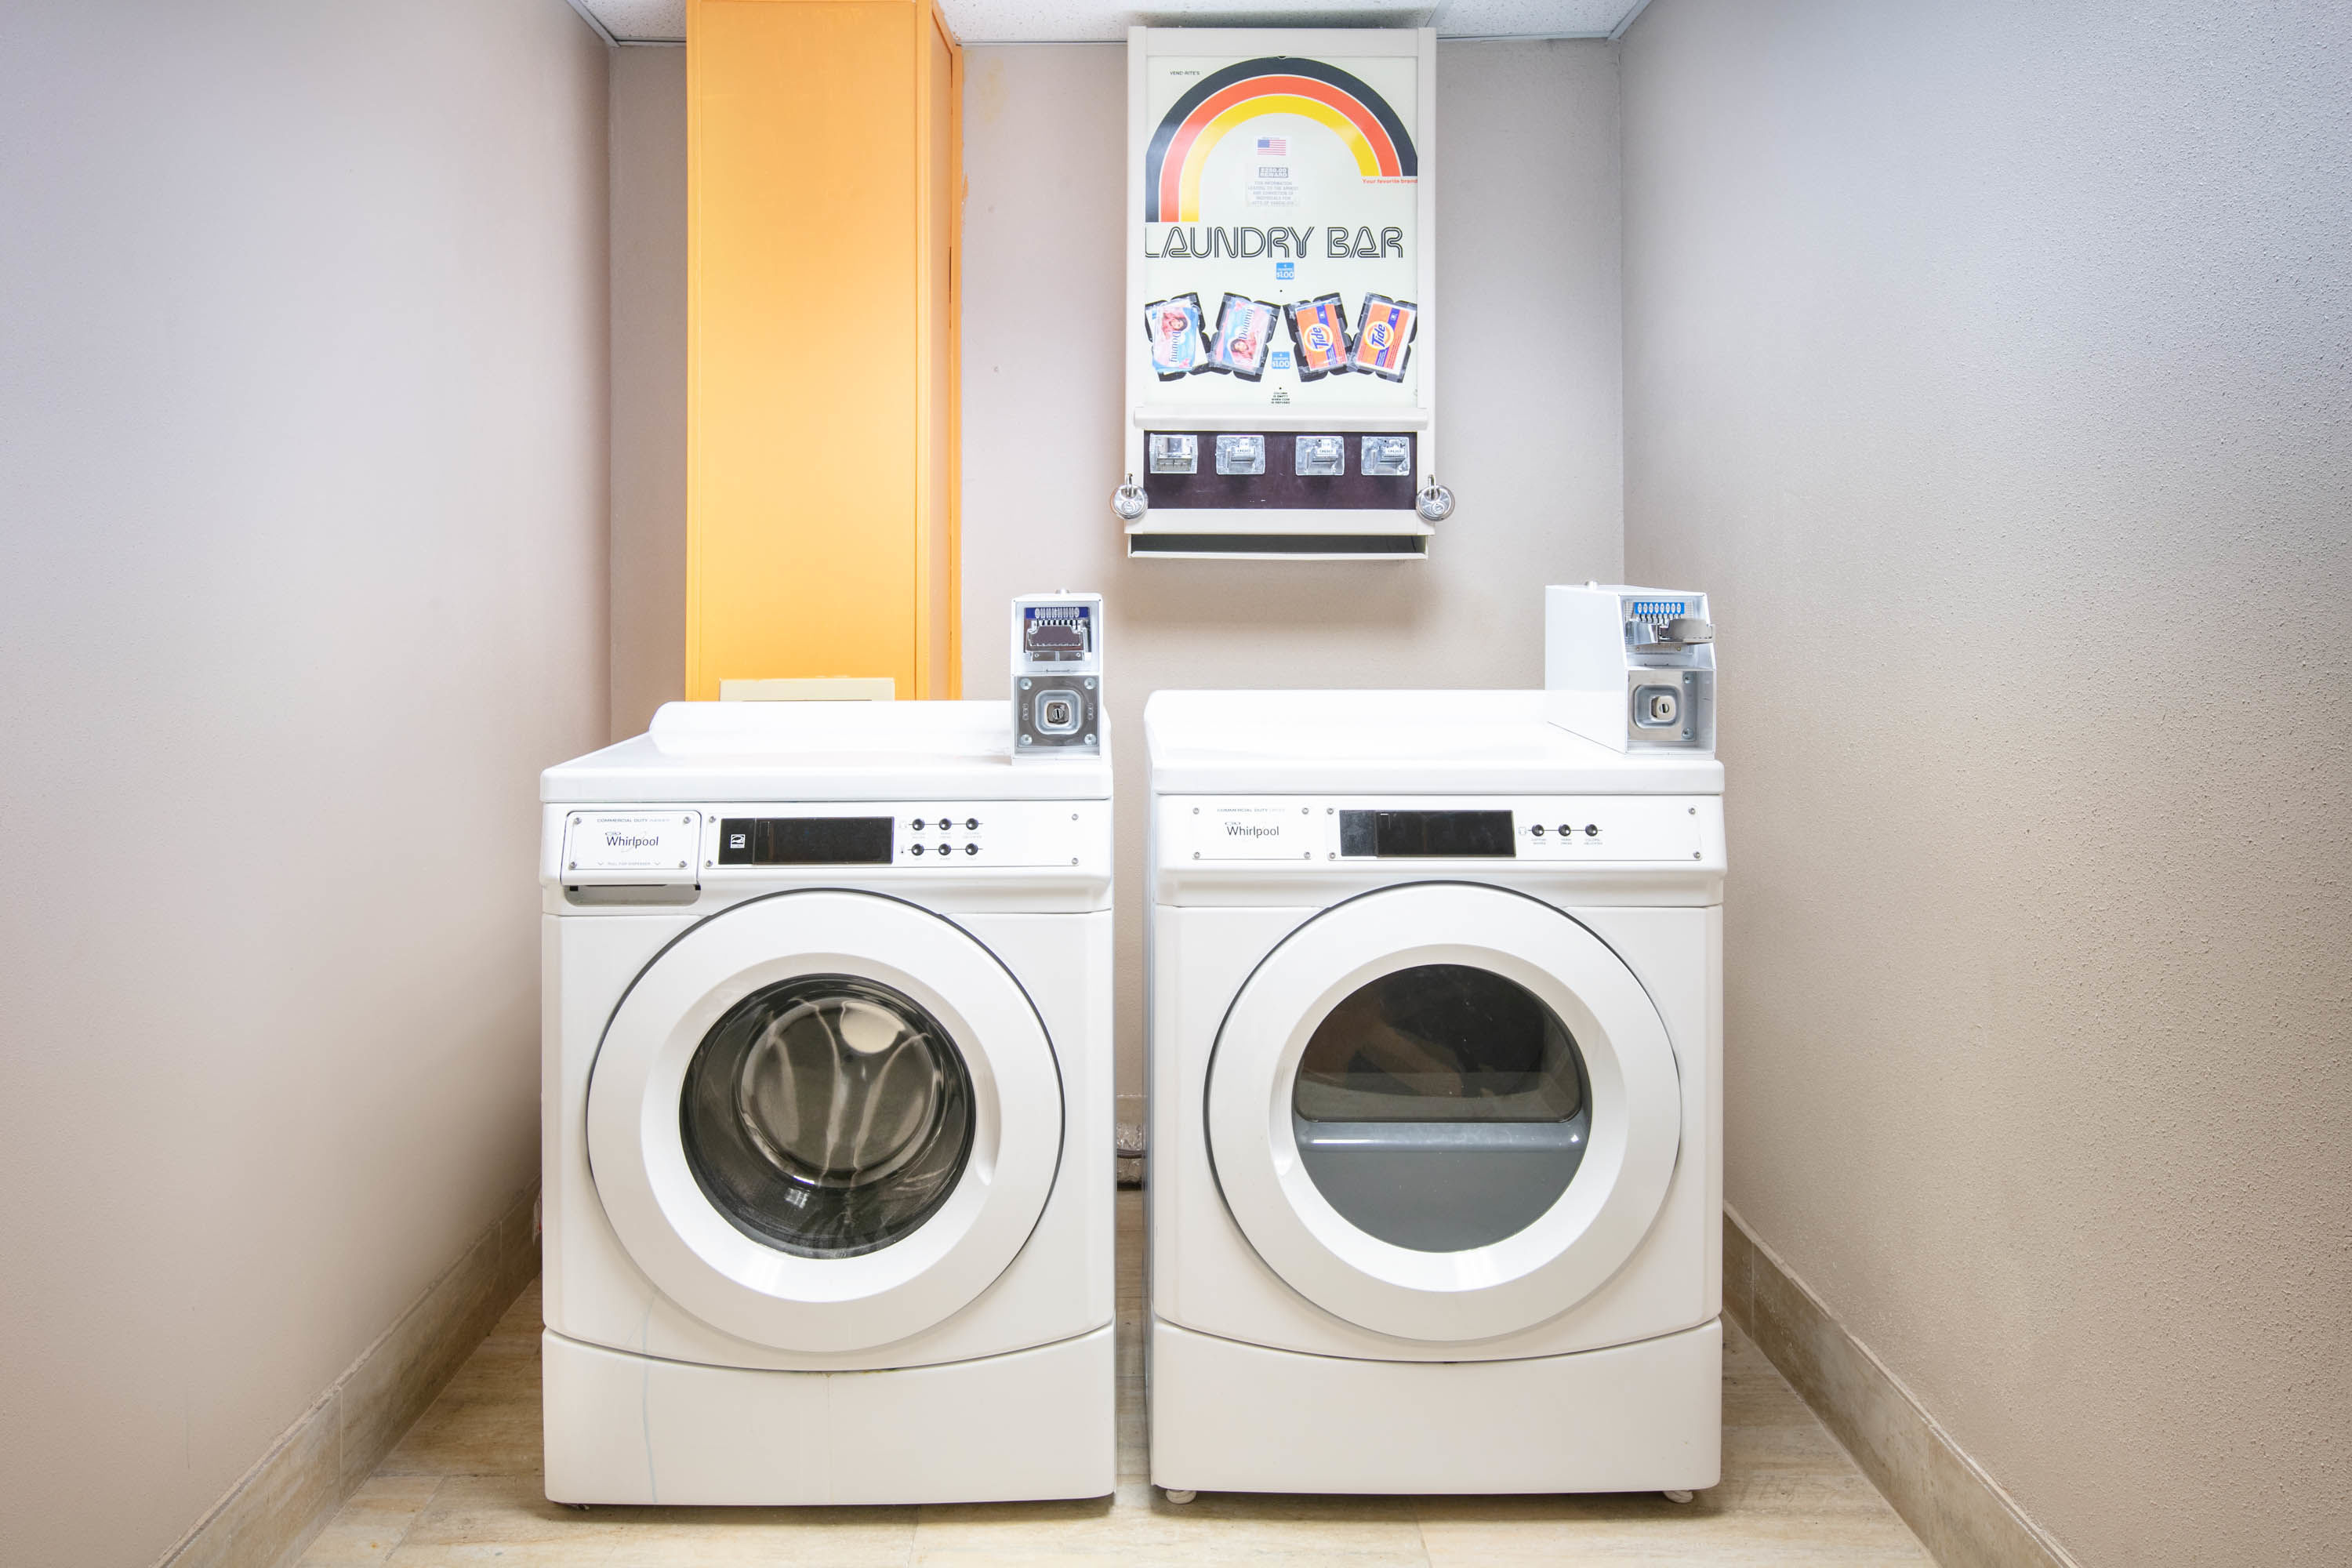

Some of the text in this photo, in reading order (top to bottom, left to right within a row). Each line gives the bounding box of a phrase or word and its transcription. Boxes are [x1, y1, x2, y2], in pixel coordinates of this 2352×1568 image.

[1145, 226, 1403, 258] LAUNDRY BAR
[1239, 308, 1255, 339] Downy
[1372, 323, 1387, 348] Tide
[1169, 331, 1181, 362] Downy
[1311, 327, 1329, 350] Tide
[606, 836, 659, 849] Whirlpool
[1227, 826, 1279, 838] Whirlpool
